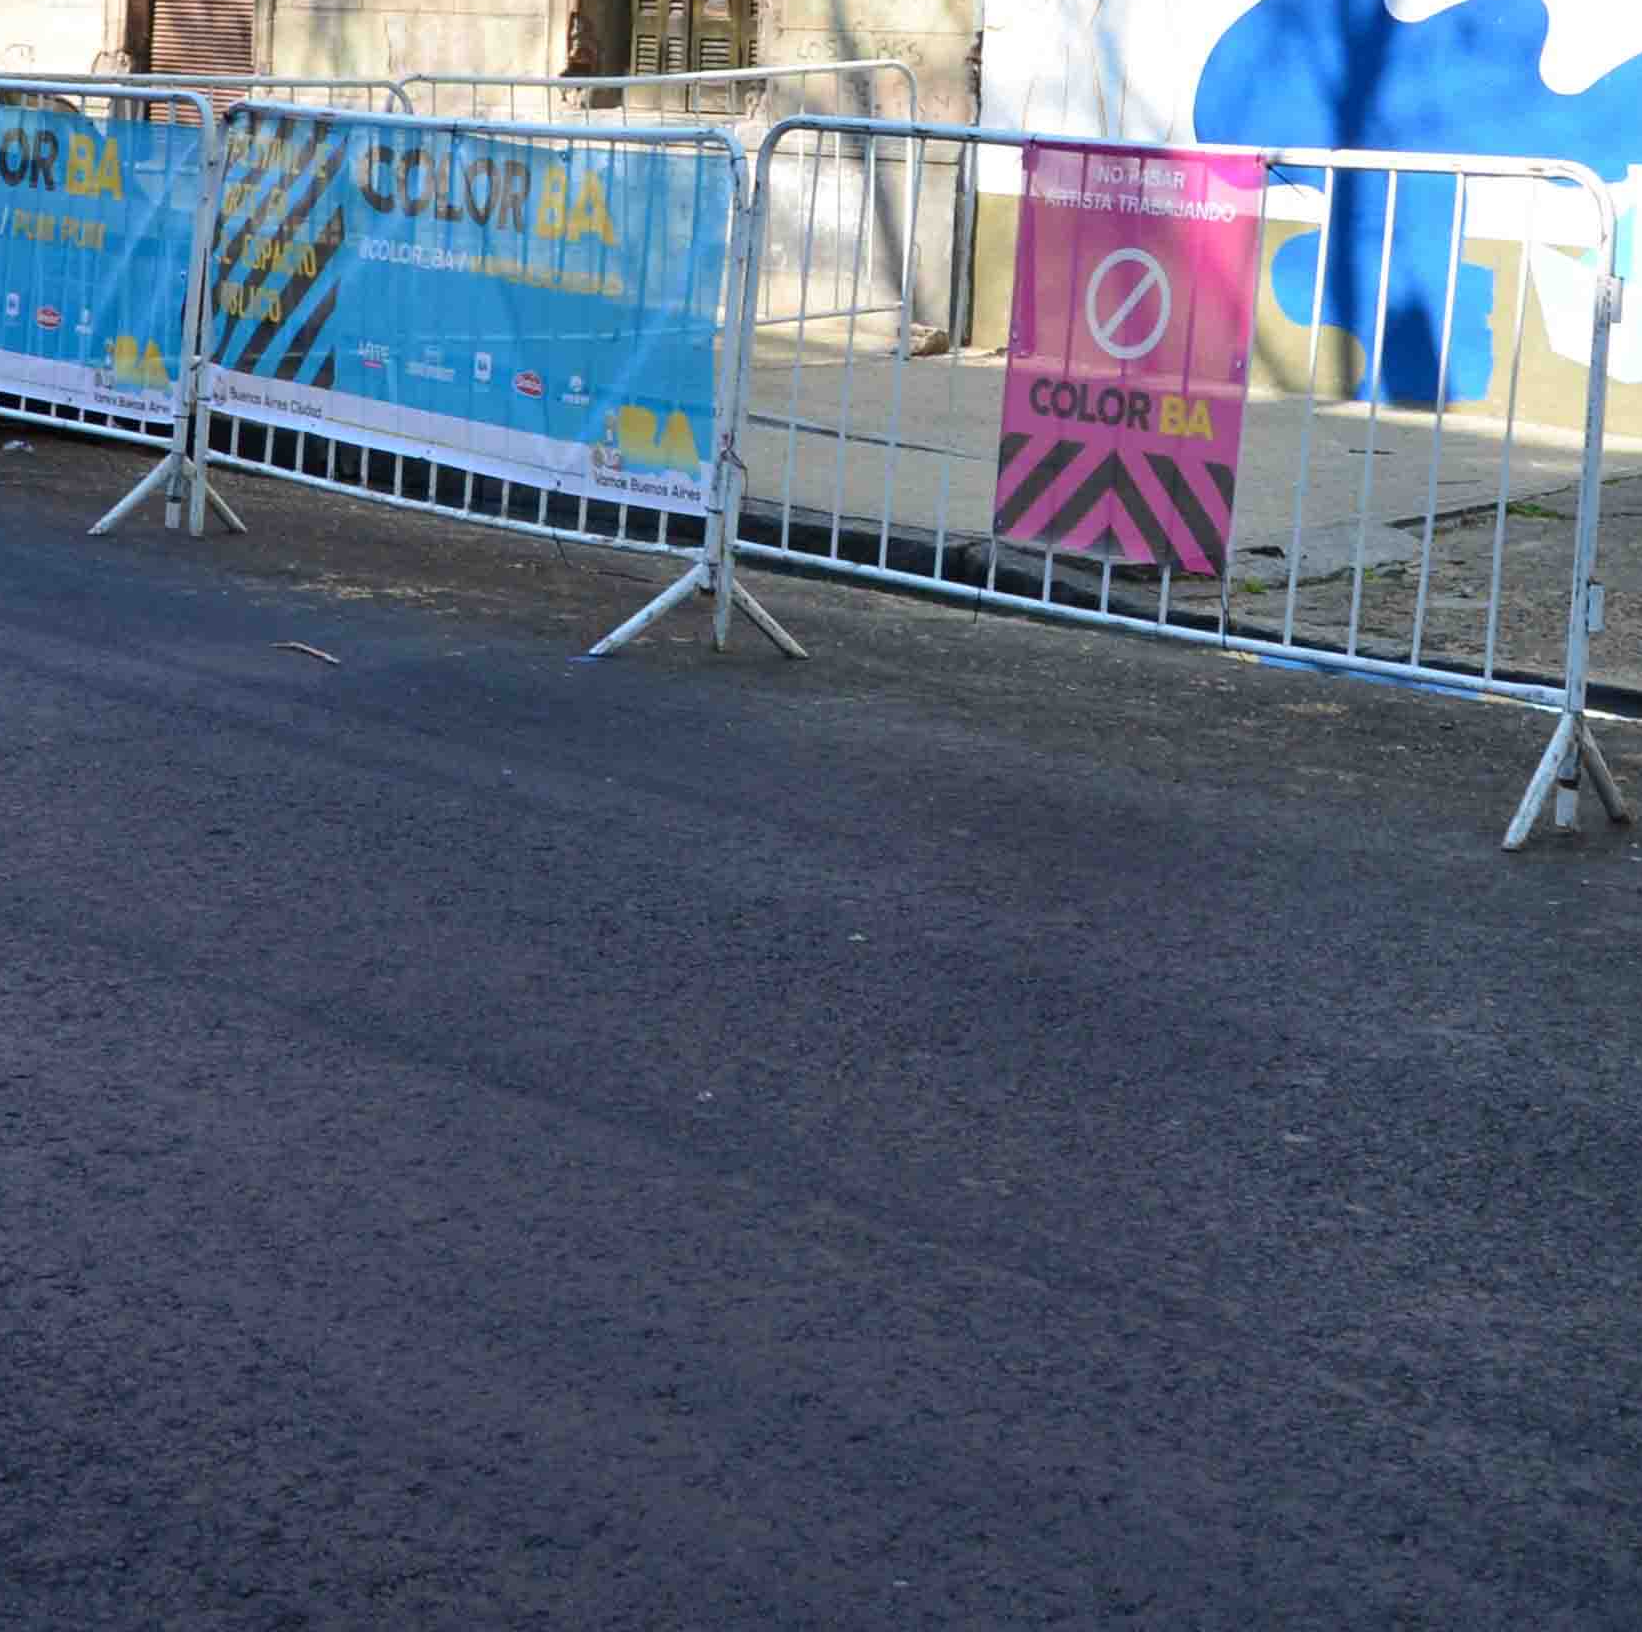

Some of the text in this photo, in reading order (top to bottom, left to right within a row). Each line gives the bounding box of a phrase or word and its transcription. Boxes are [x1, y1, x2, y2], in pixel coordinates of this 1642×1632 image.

[65, 132, 123, 201] BA
[359, 145, 532, 232] COLOR
[534, 167, 615, 246] BA
[1095, 164, 1124, 184] NO
[1118, 193, 1237, 223] TRABAJANDO
[1029, 377, 1214, 441] COLOR BA
